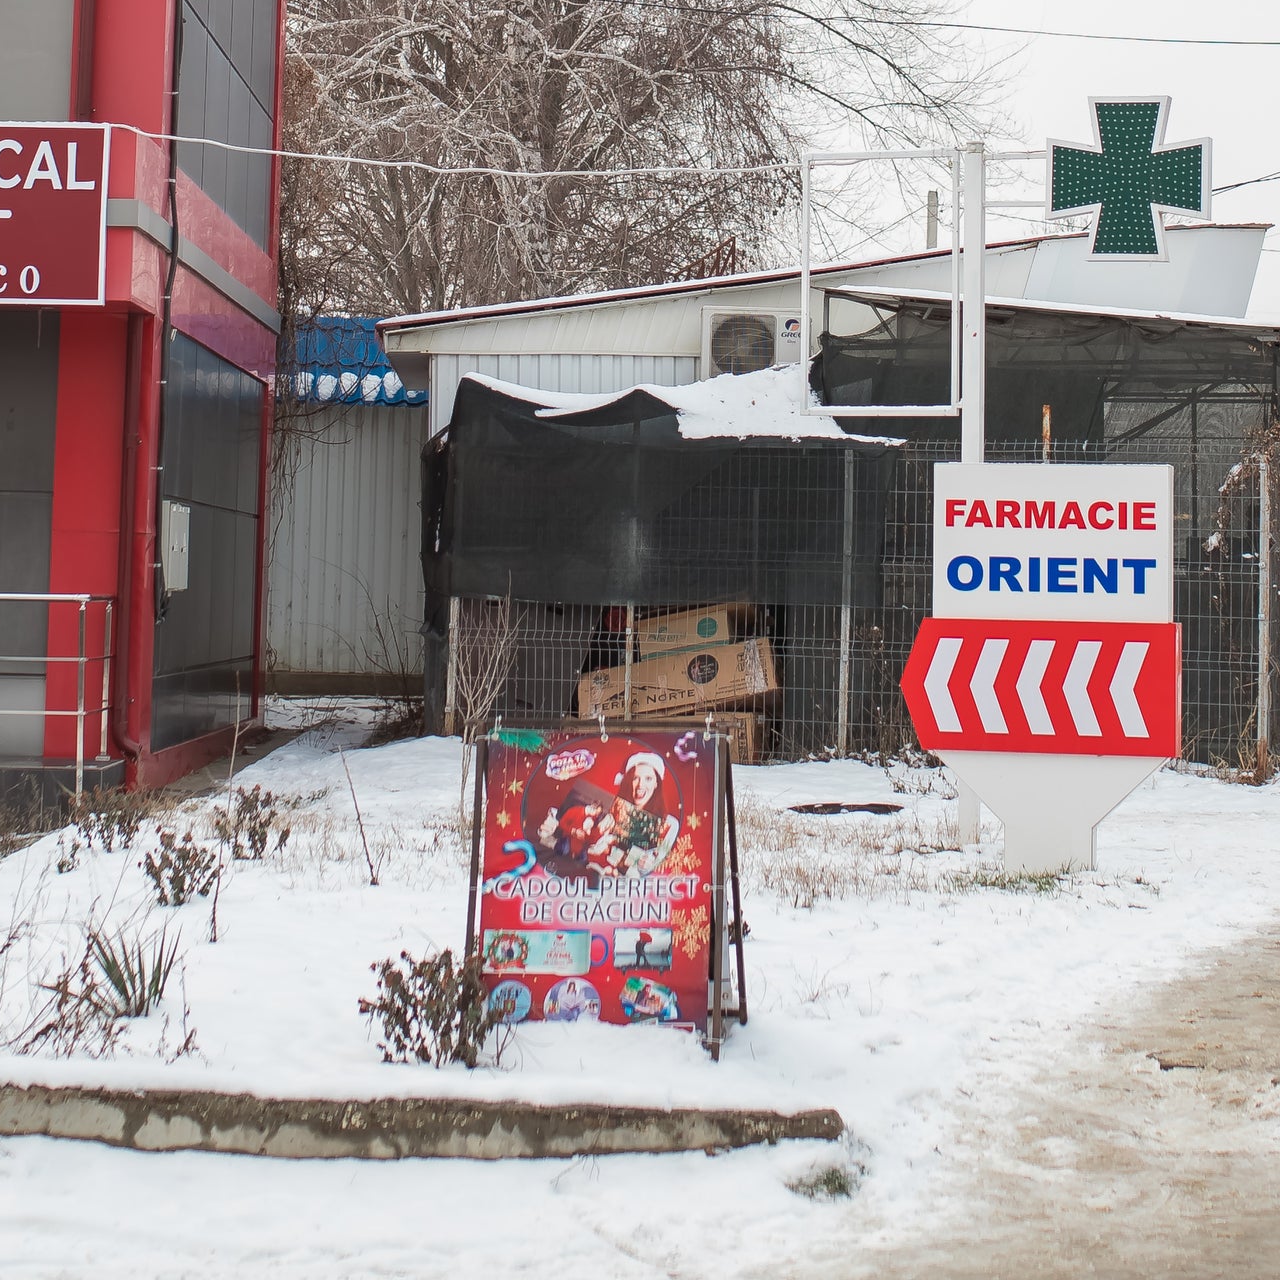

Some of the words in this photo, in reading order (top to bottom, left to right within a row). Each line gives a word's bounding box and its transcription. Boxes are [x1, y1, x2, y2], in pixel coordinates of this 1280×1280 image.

[945, 499, 1157, 531] FARMACIE
[946, 555, 1157, 595] ORIENT
[495, 876, 592, 898] CADOUL
[600, 876, 700, 899] PERFECT
[523, 901, 552, 922] DE
